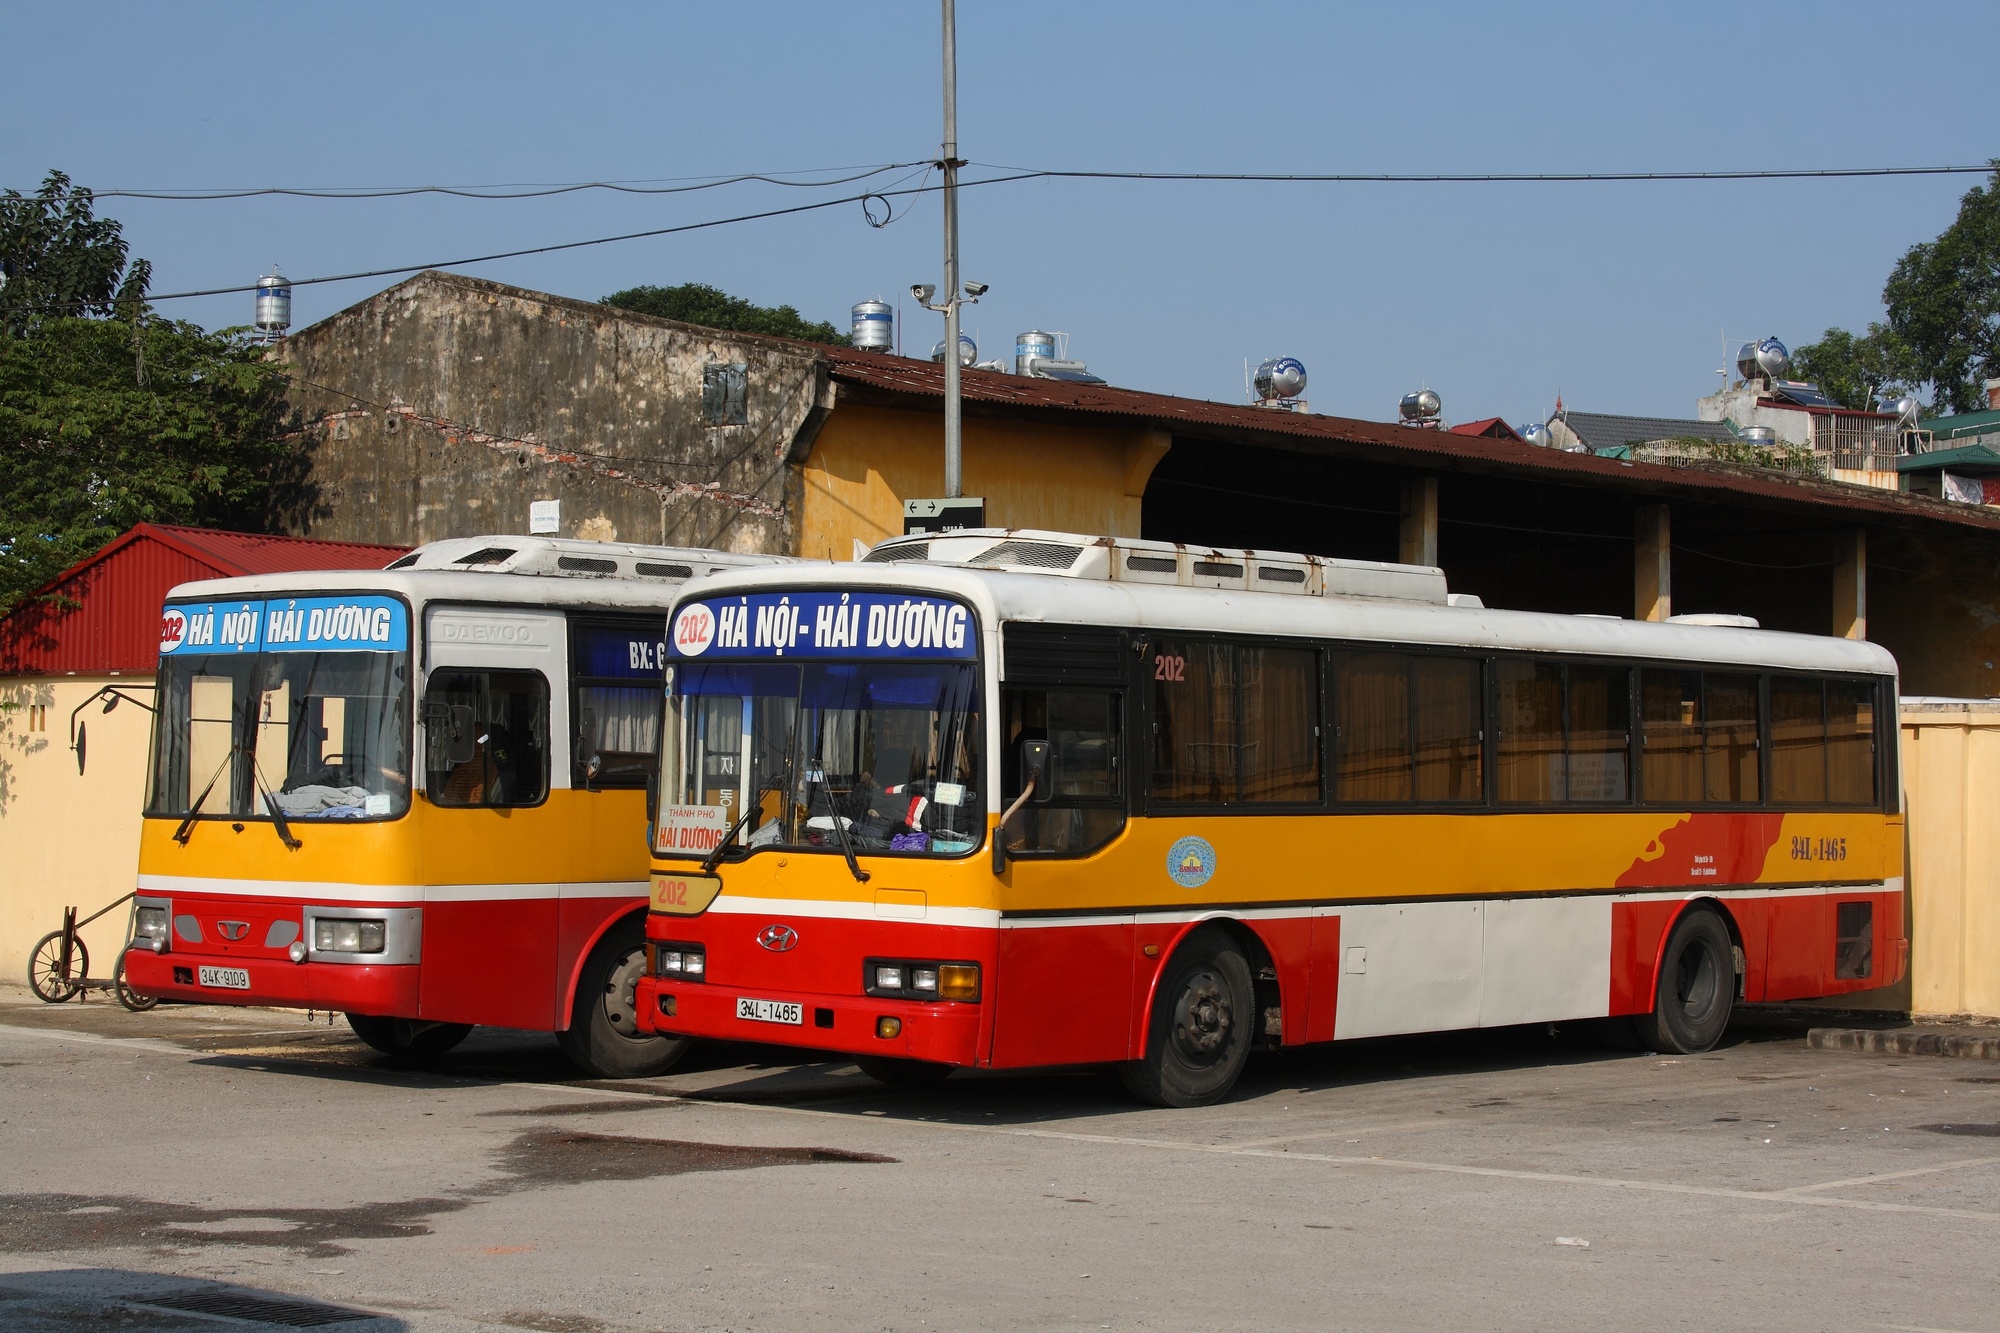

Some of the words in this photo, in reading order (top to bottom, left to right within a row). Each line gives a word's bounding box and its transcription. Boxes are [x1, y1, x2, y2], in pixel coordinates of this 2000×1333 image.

[187, 606, 214, 645] HÀ
[220, 604, 259, 651] NỘI
[267, 599, 304, 643] HẢI
[307, 604, 391, 642] DƯƠNG
[442, 623, 534, 643] DAEWOO
[679, 613, 709, 645] 202
[717, 596, 748, 648] HÀ
[814, 593, 861, 648] HẢI
[866, 600, 967, 649] DƯƠNG
[629, 641, 653, 670] BX:
[1155, 655, 1185, 681] 202
[669, 807, 696, 818] THÀNH
[697, 807, 716, 819] PHỐ
[659, 820, 677, 848] HẢI
[679, 826, 723, 850] DƯƠNG
[657, 879, 688, 907] 202
[201, 969, 246, 986] 34K-9109
[740, 1000, 798, 1021] 34L-1465
